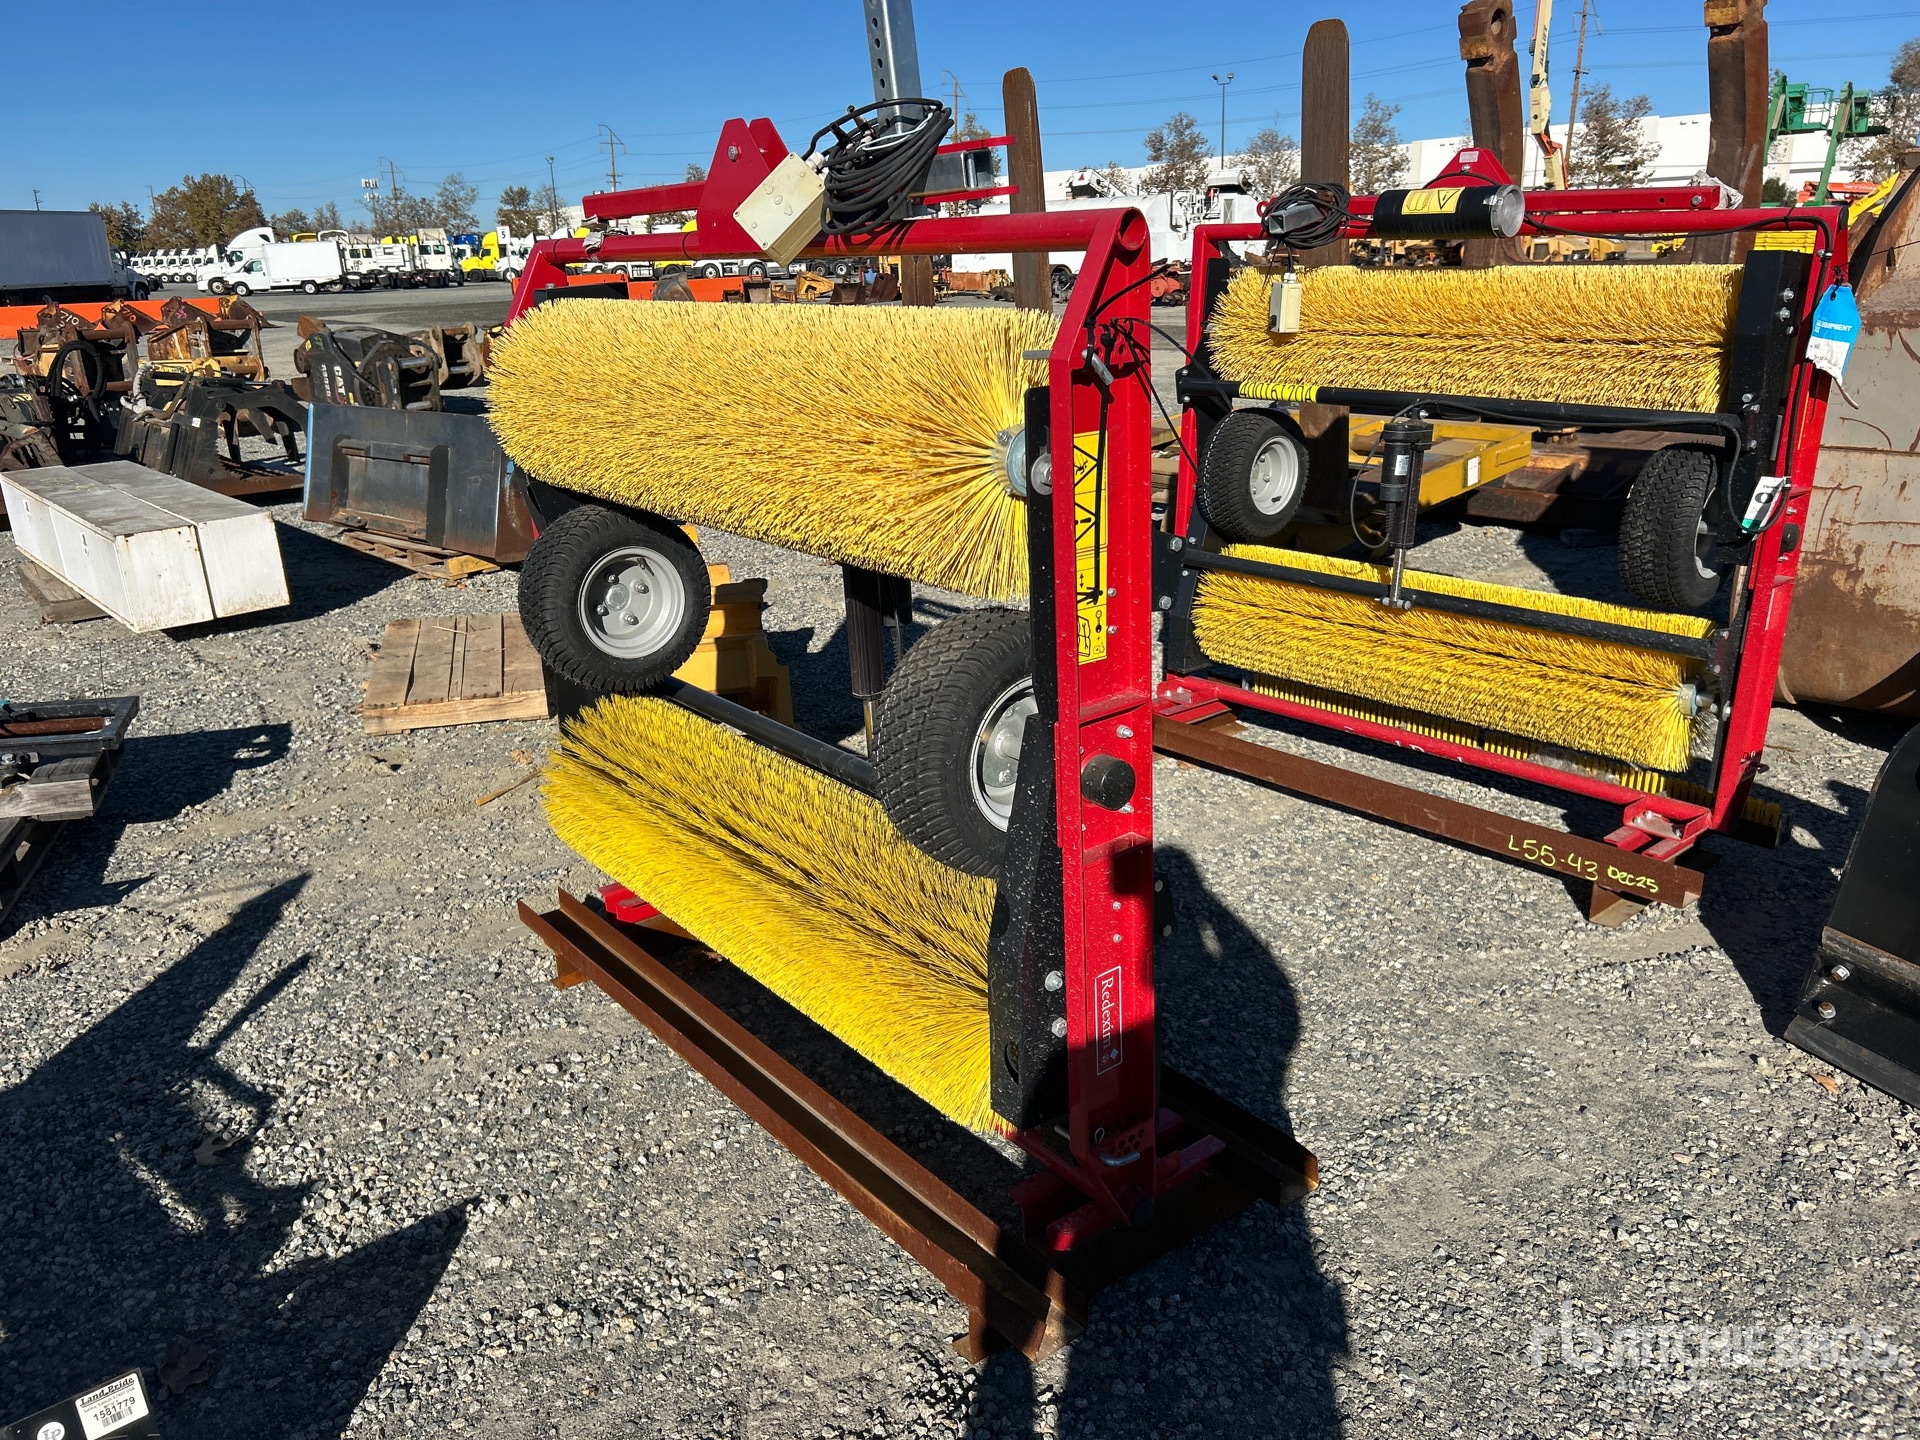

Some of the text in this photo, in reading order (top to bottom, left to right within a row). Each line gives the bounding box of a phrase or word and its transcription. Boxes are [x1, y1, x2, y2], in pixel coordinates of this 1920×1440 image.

[501, 231, 506, 239] 5
[334, 365, 346, 396] CAT
[1508, 835, 1599, 881] L55-43
[1101, 976, 1115, 1049] Redexim
[80, 1377, 135, 1406] Land Pride
[93, 1397, 136, 1421] 1581779
